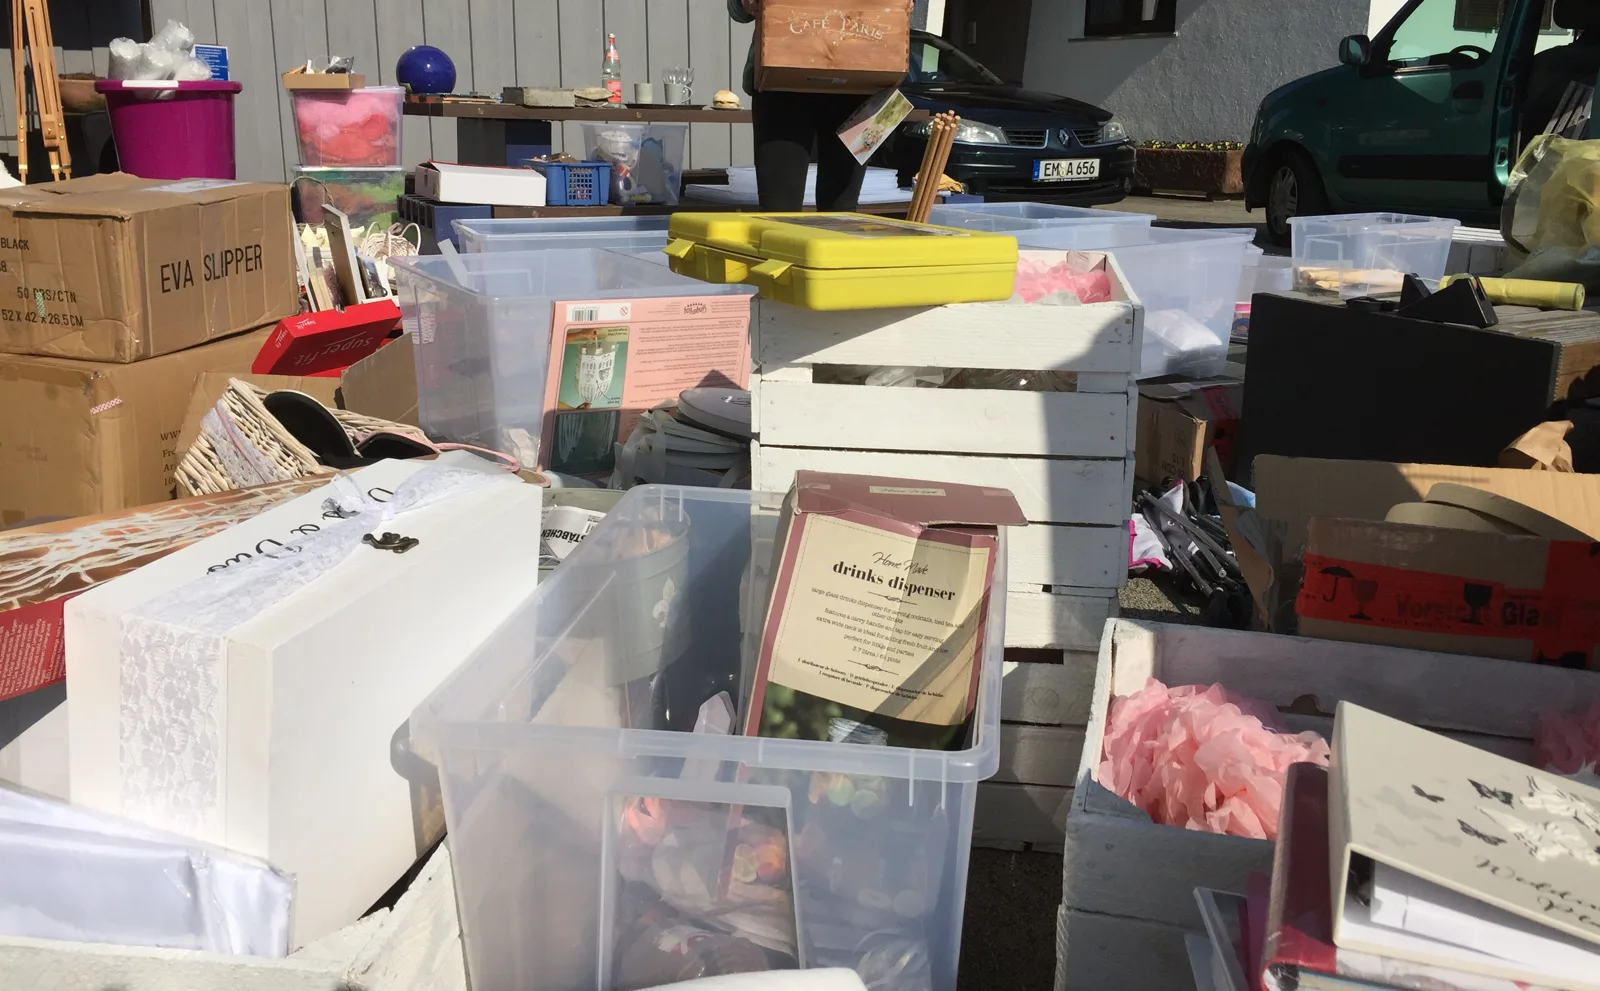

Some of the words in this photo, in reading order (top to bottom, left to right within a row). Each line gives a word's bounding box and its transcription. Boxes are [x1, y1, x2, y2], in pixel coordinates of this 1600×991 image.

[841, 18, 883, 40] PARIS
[1044, 162, 1060, 176] EM
[1066, 162, 1073, 176] A
[1076, 161, 1096, 175] 656
[0, 237, 30, 251] BLACK
[160, 260, 194, 294] EVA
[203, 244, 263, 282] SLIPPER
[16, 286, 30, 300] 50
[872, 551, 902, 570] Home
[832, 561, 884, 585] drinks
[888, 576, 956, 601] dispenser
